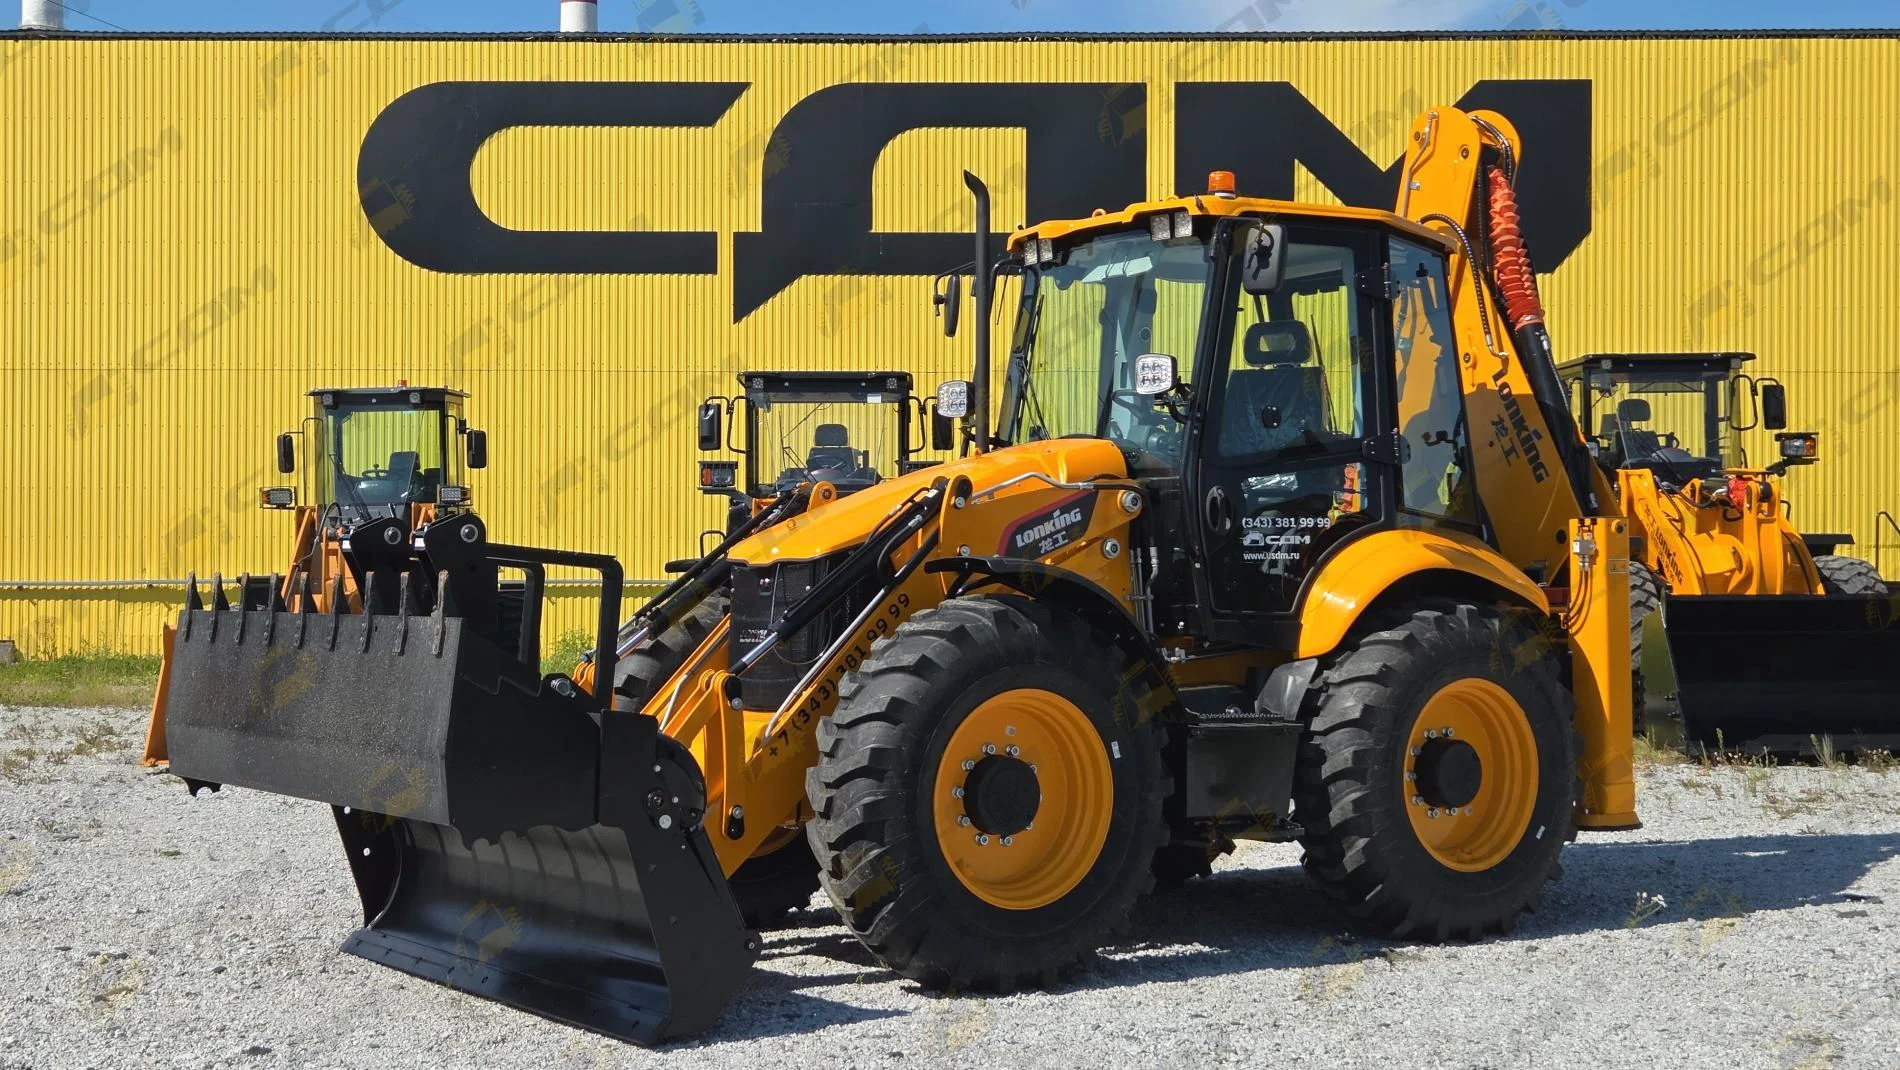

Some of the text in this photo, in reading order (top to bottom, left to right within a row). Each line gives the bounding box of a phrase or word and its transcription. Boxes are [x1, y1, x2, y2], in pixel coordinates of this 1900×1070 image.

[1242, 517, 1331, 528] (343) 381 99 99
[1243, 551, 1300, 560] www.usdm.ru
[791, 678, 837, 731] (343)
[888, 593, 910, 619] 99
